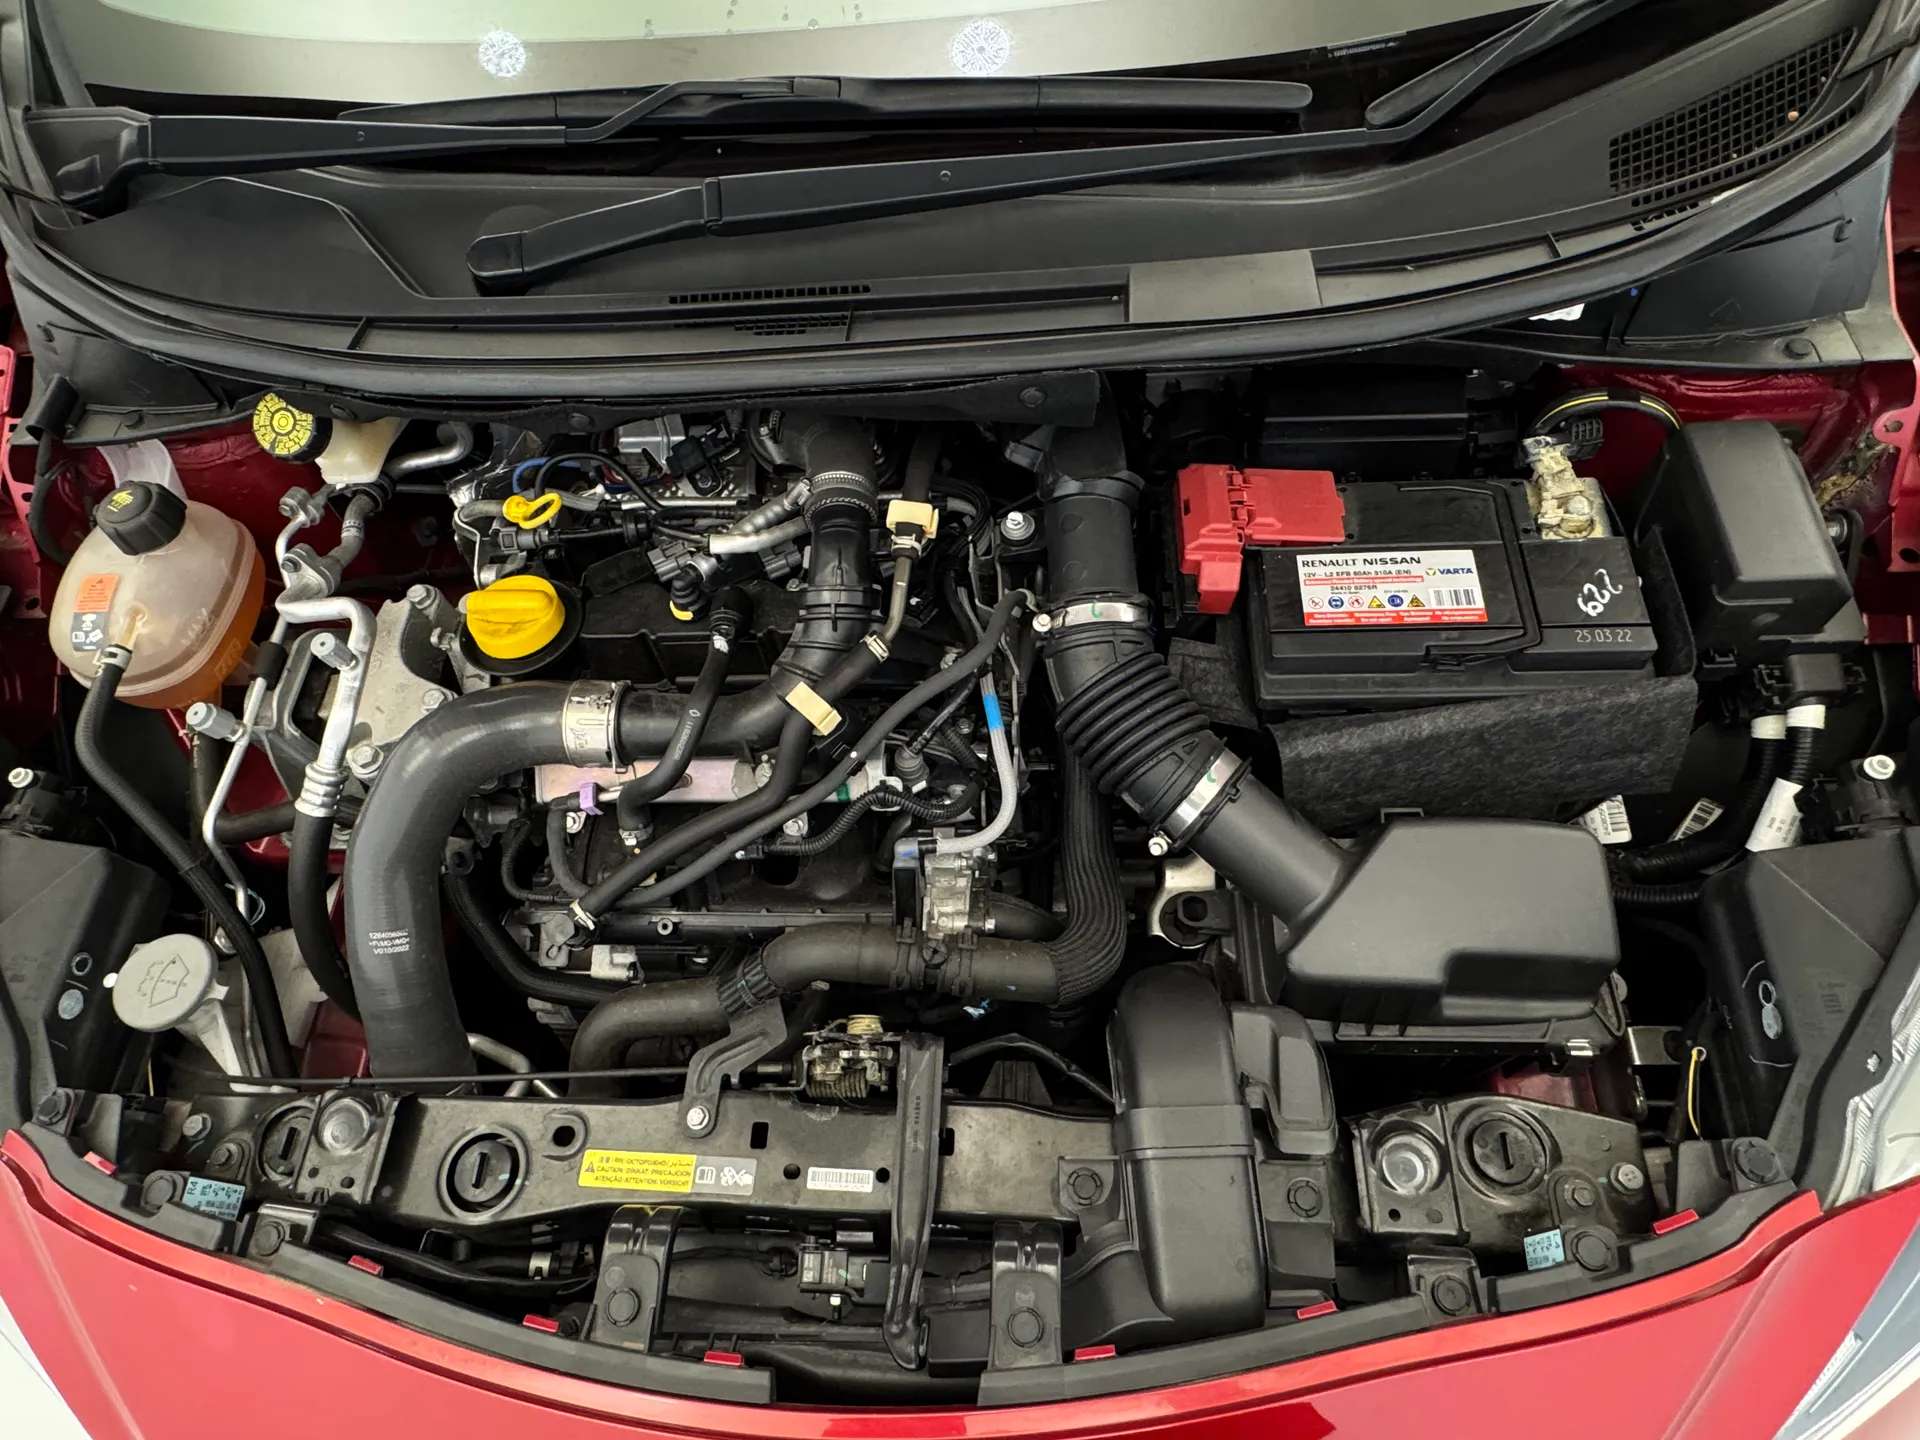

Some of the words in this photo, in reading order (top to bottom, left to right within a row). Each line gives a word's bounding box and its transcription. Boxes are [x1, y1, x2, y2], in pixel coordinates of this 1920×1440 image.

[1302, 559, 1358, 568] RENAULT
[1363, 556, 1422, 566] NISSAN
[1438, 567, 1474, 575] VARTA
